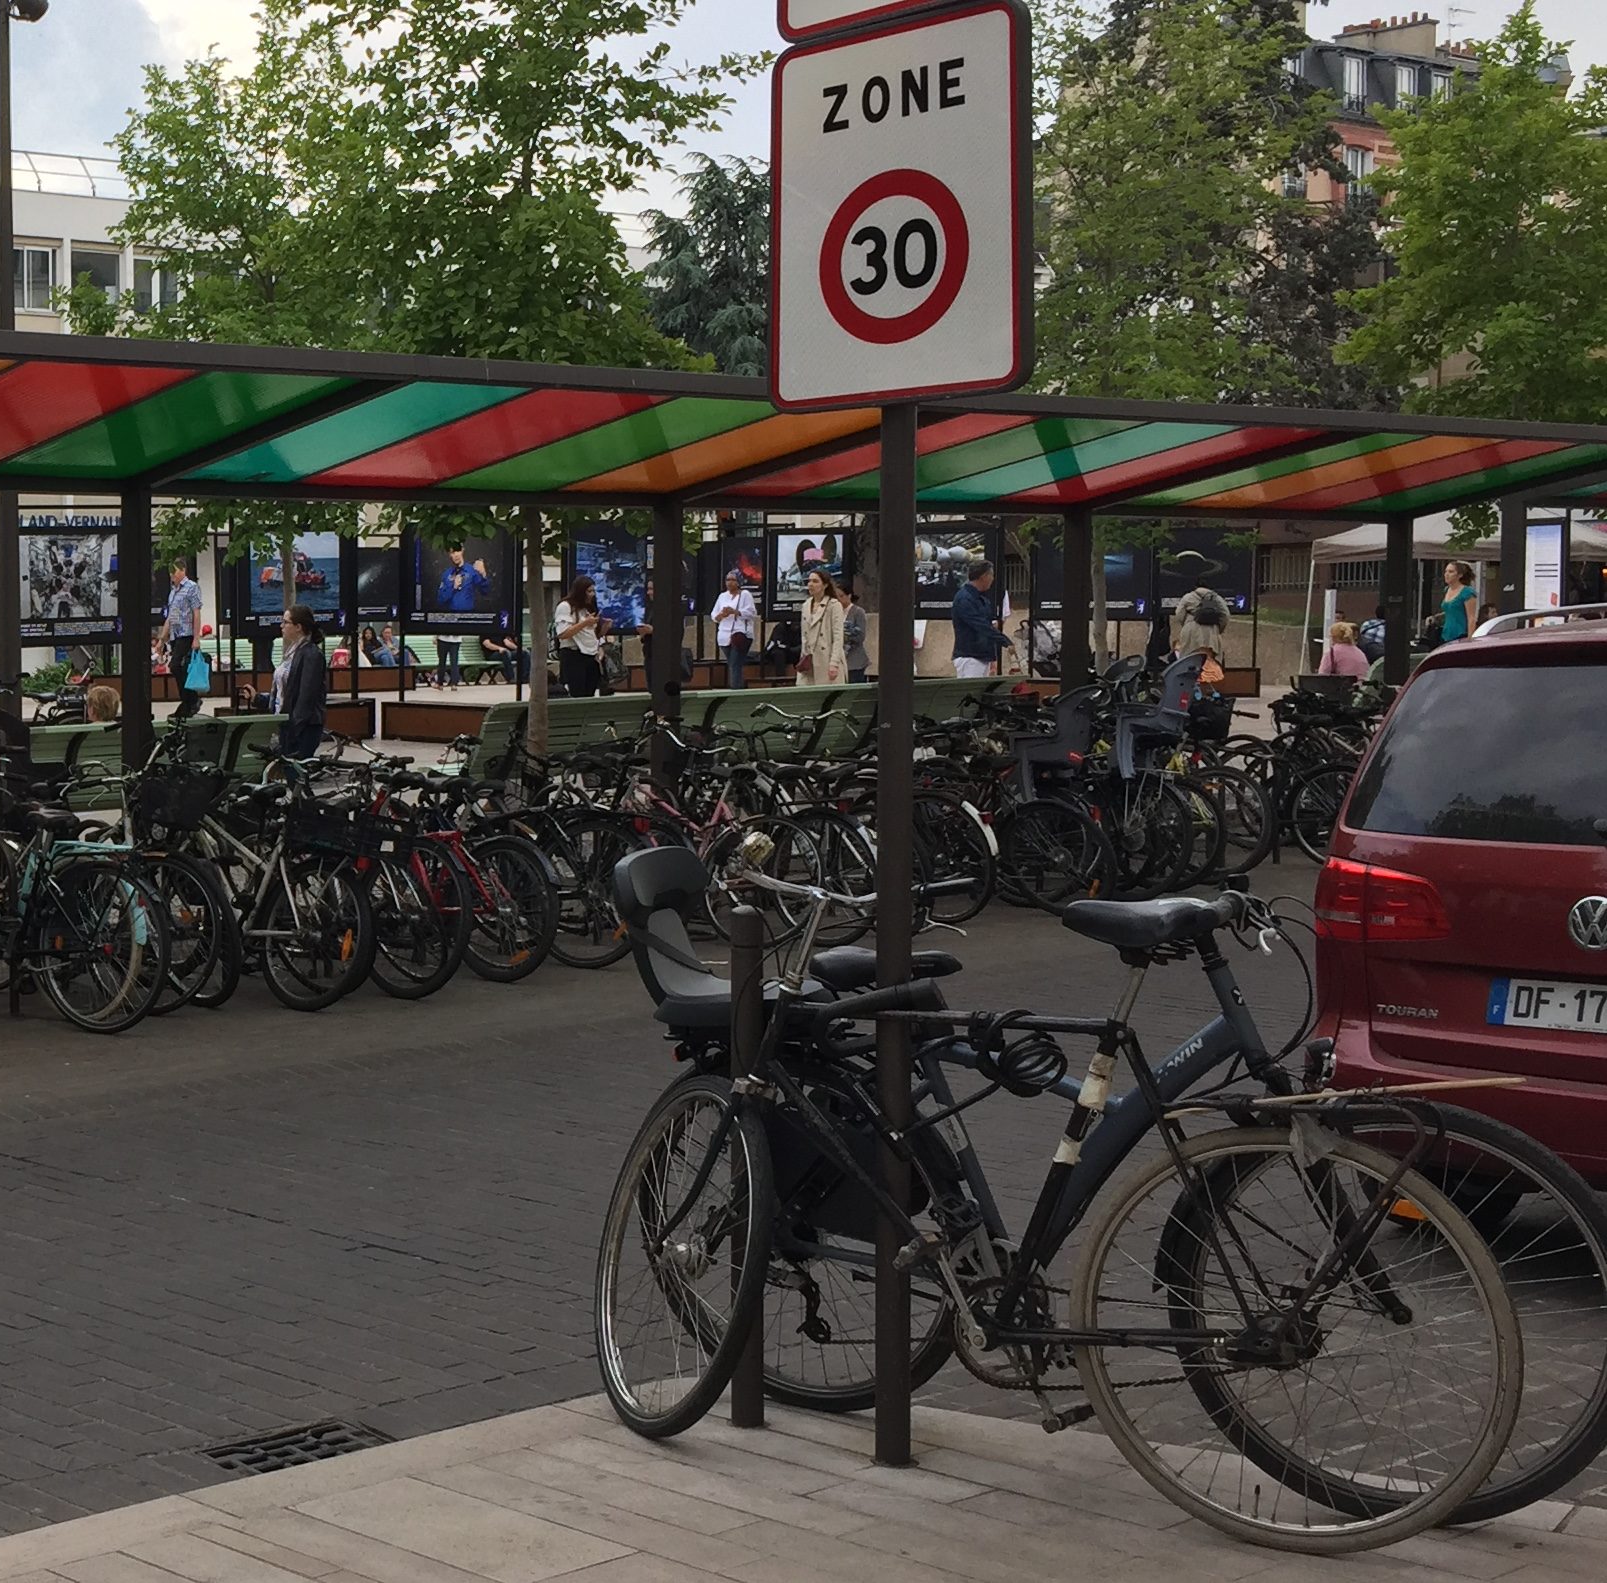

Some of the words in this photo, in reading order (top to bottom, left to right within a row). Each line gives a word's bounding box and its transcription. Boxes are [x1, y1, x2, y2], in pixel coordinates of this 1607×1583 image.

[822, 57, 966, 133] ZONE
[849, 218, 938, 295] 30
[1376, 1003, 1439, 1019] TOURAN
[1493, 1004, 1500, 1015] F
